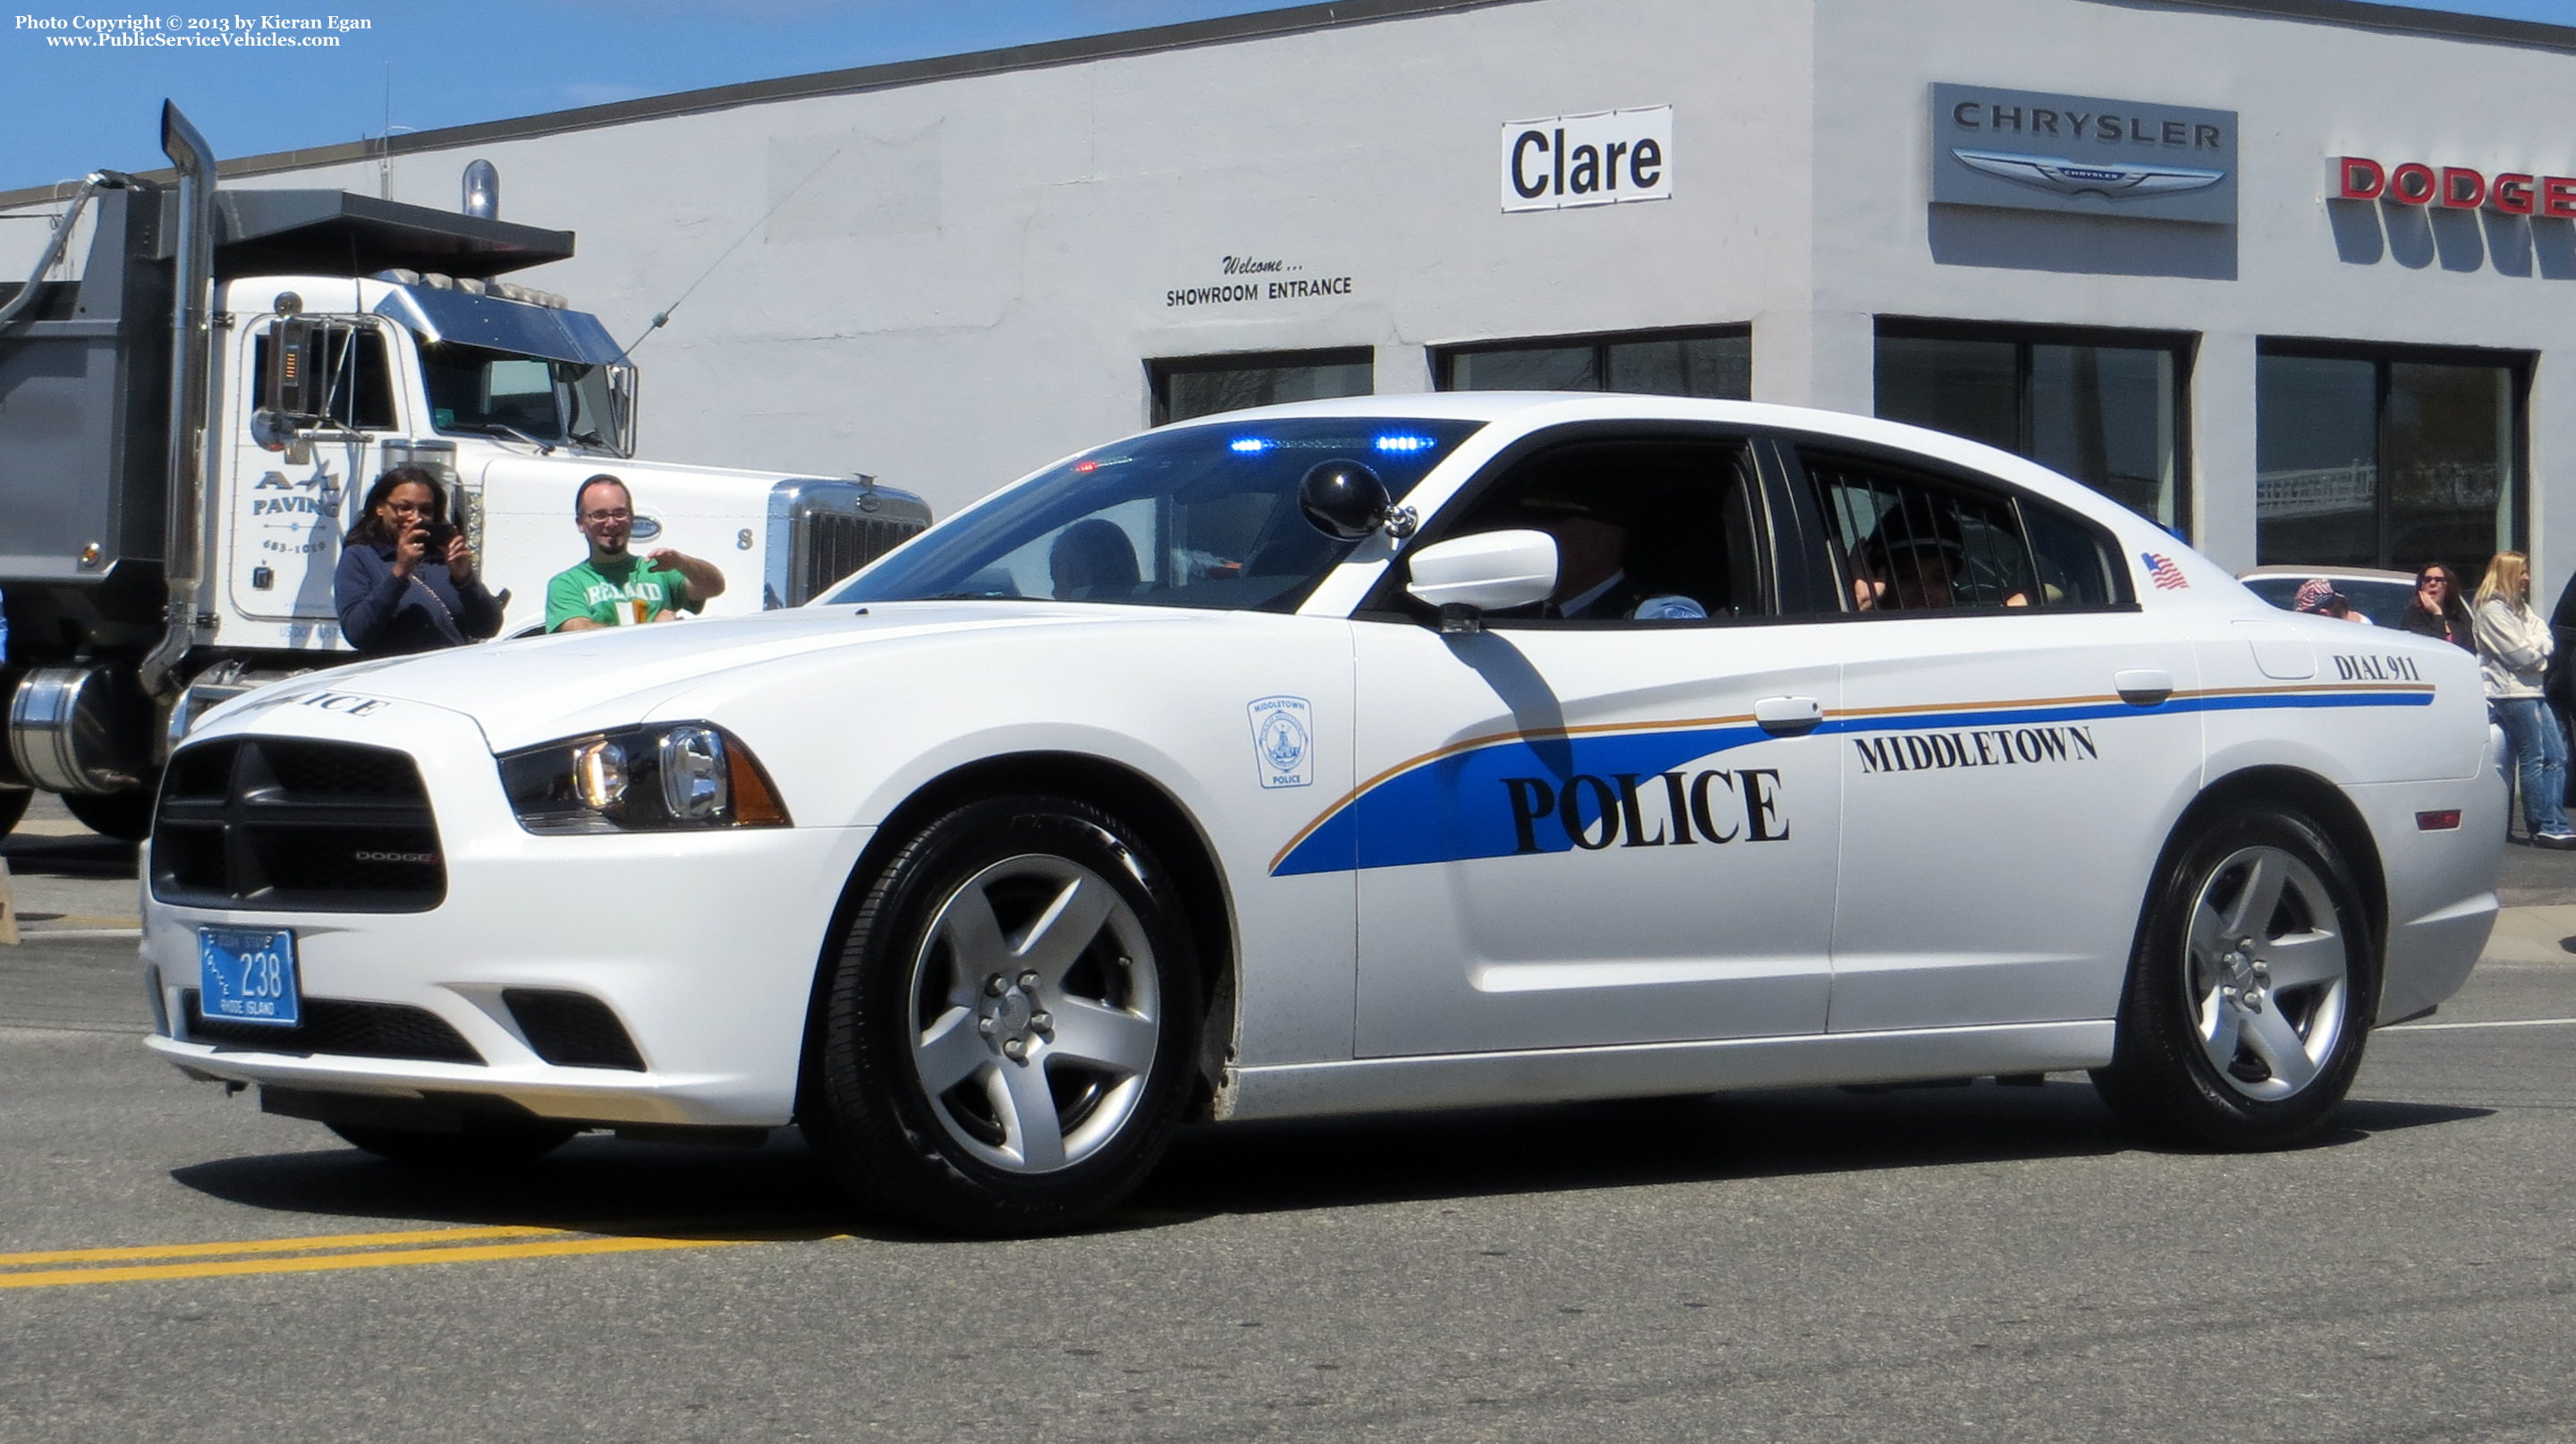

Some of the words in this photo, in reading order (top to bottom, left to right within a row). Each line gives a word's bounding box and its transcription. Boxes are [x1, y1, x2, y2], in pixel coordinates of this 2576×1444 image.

[1953, 102, 2220, 149] CHRYSLER
[1512, 128, 1661, 199] Clare
[2063, 169, 2119, 180] CHRYSLER
[2340, 157, 2576, 218] DODGE
[1166, 284, 1258, 306] SHOWROOM
[1268, 277, 1352, 300] ENTRANCE
[254, 471, 340, 490] A-1
[253, 497, 341, 518] PAVING
[737, 528, 753, 550] 8
[2333, 655, 2388, 680] DIAL
[2386, 655, 2420, 680] 911
[1254, 701, 1305, 712] MIDDLETOWN
[1852, 726, 2098, 774] MIDDLETOWN
[1273, 775, 1301, 784] POLICE
[1499, 769, 1790, 854] POLICE
[356, 852, 431, 862] DODGE
[240, 952, 282, 998] 238
[220, 999, 243, 1014] RHODE
[246, 1001, 275, 1015] ISLAND
